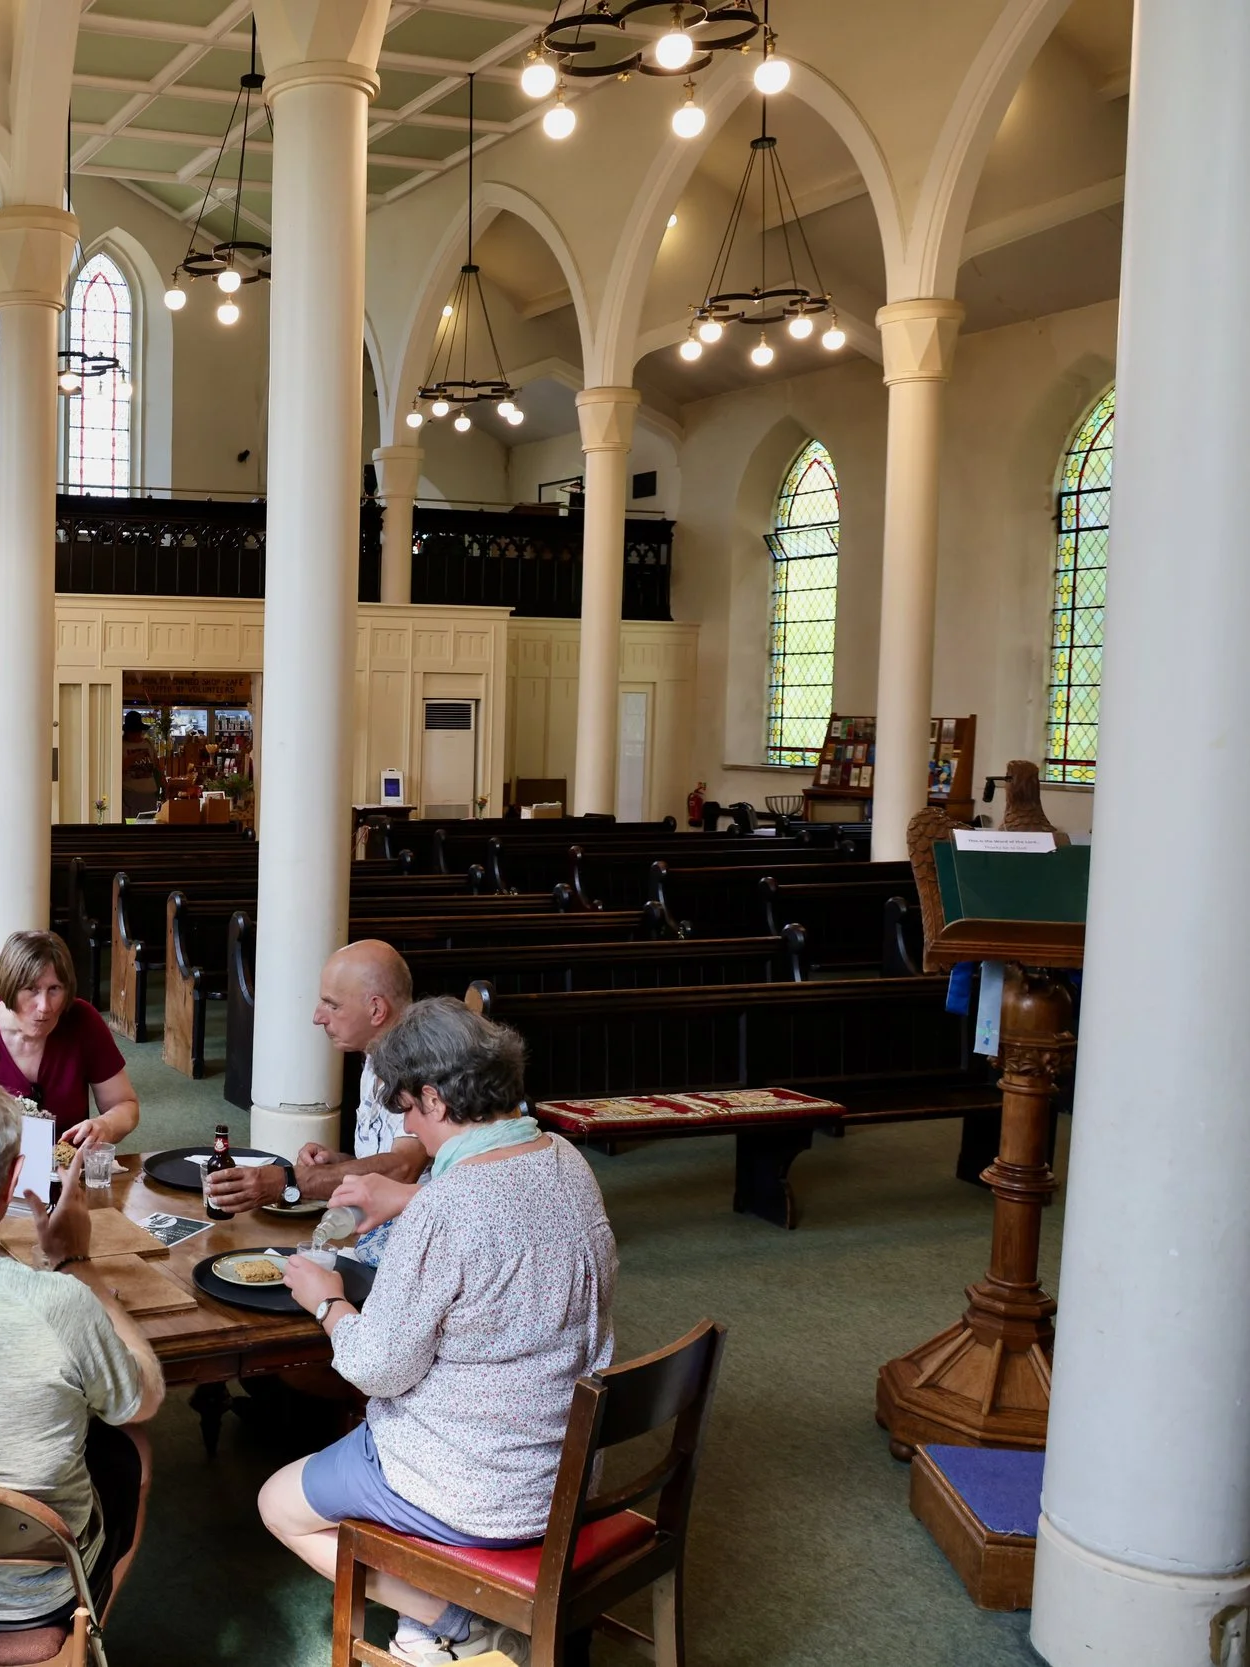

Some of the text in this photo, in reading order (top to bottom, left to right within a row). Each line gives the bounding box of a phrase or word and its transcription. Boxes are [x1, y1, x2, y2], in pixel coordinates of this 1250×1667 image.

[125, 677, 168, 686] COMUNITY
[201, 677, 221, 686] SHOP
[188, 685, 236, 694] VOLUNTEERS
